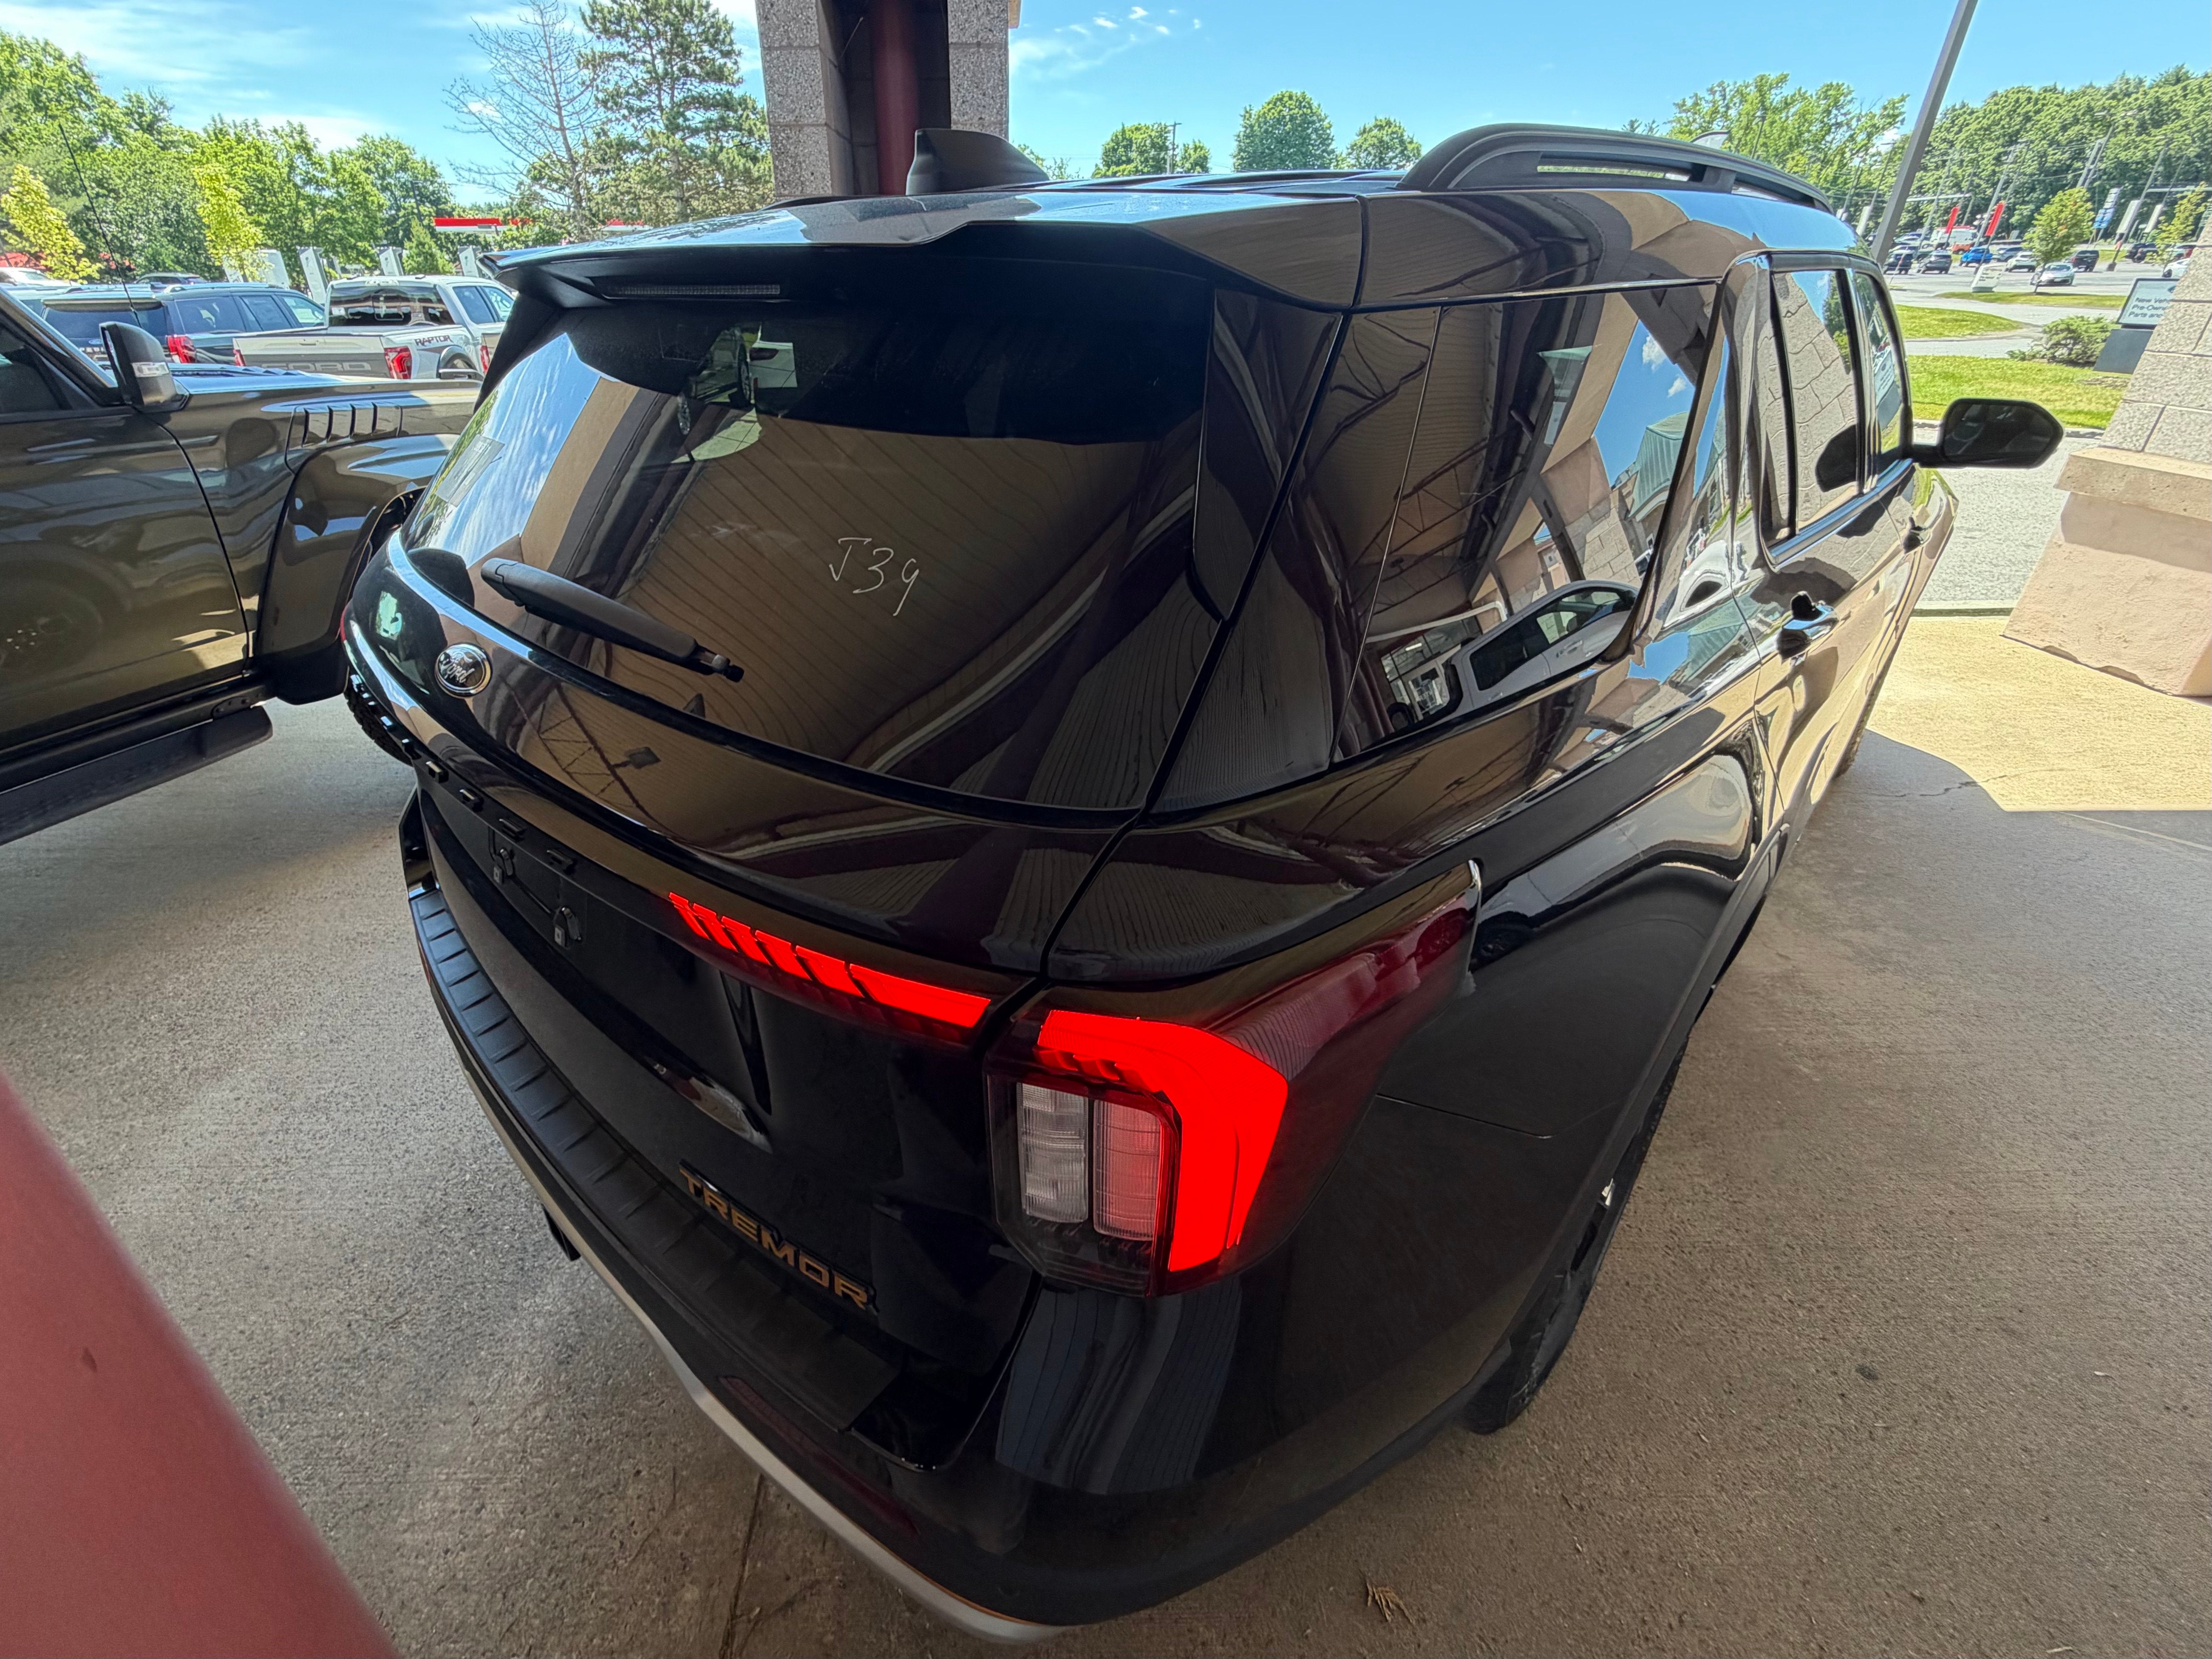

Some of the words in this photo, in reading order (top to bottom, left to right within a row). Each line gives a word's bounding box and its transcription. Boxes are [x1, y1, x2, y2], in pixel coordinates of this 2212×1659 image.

[414, 335, 454, 346] RAPTOR
[441, 651, 476, 683] Ford
[679, 1164, 870, 1311] TREMOR
